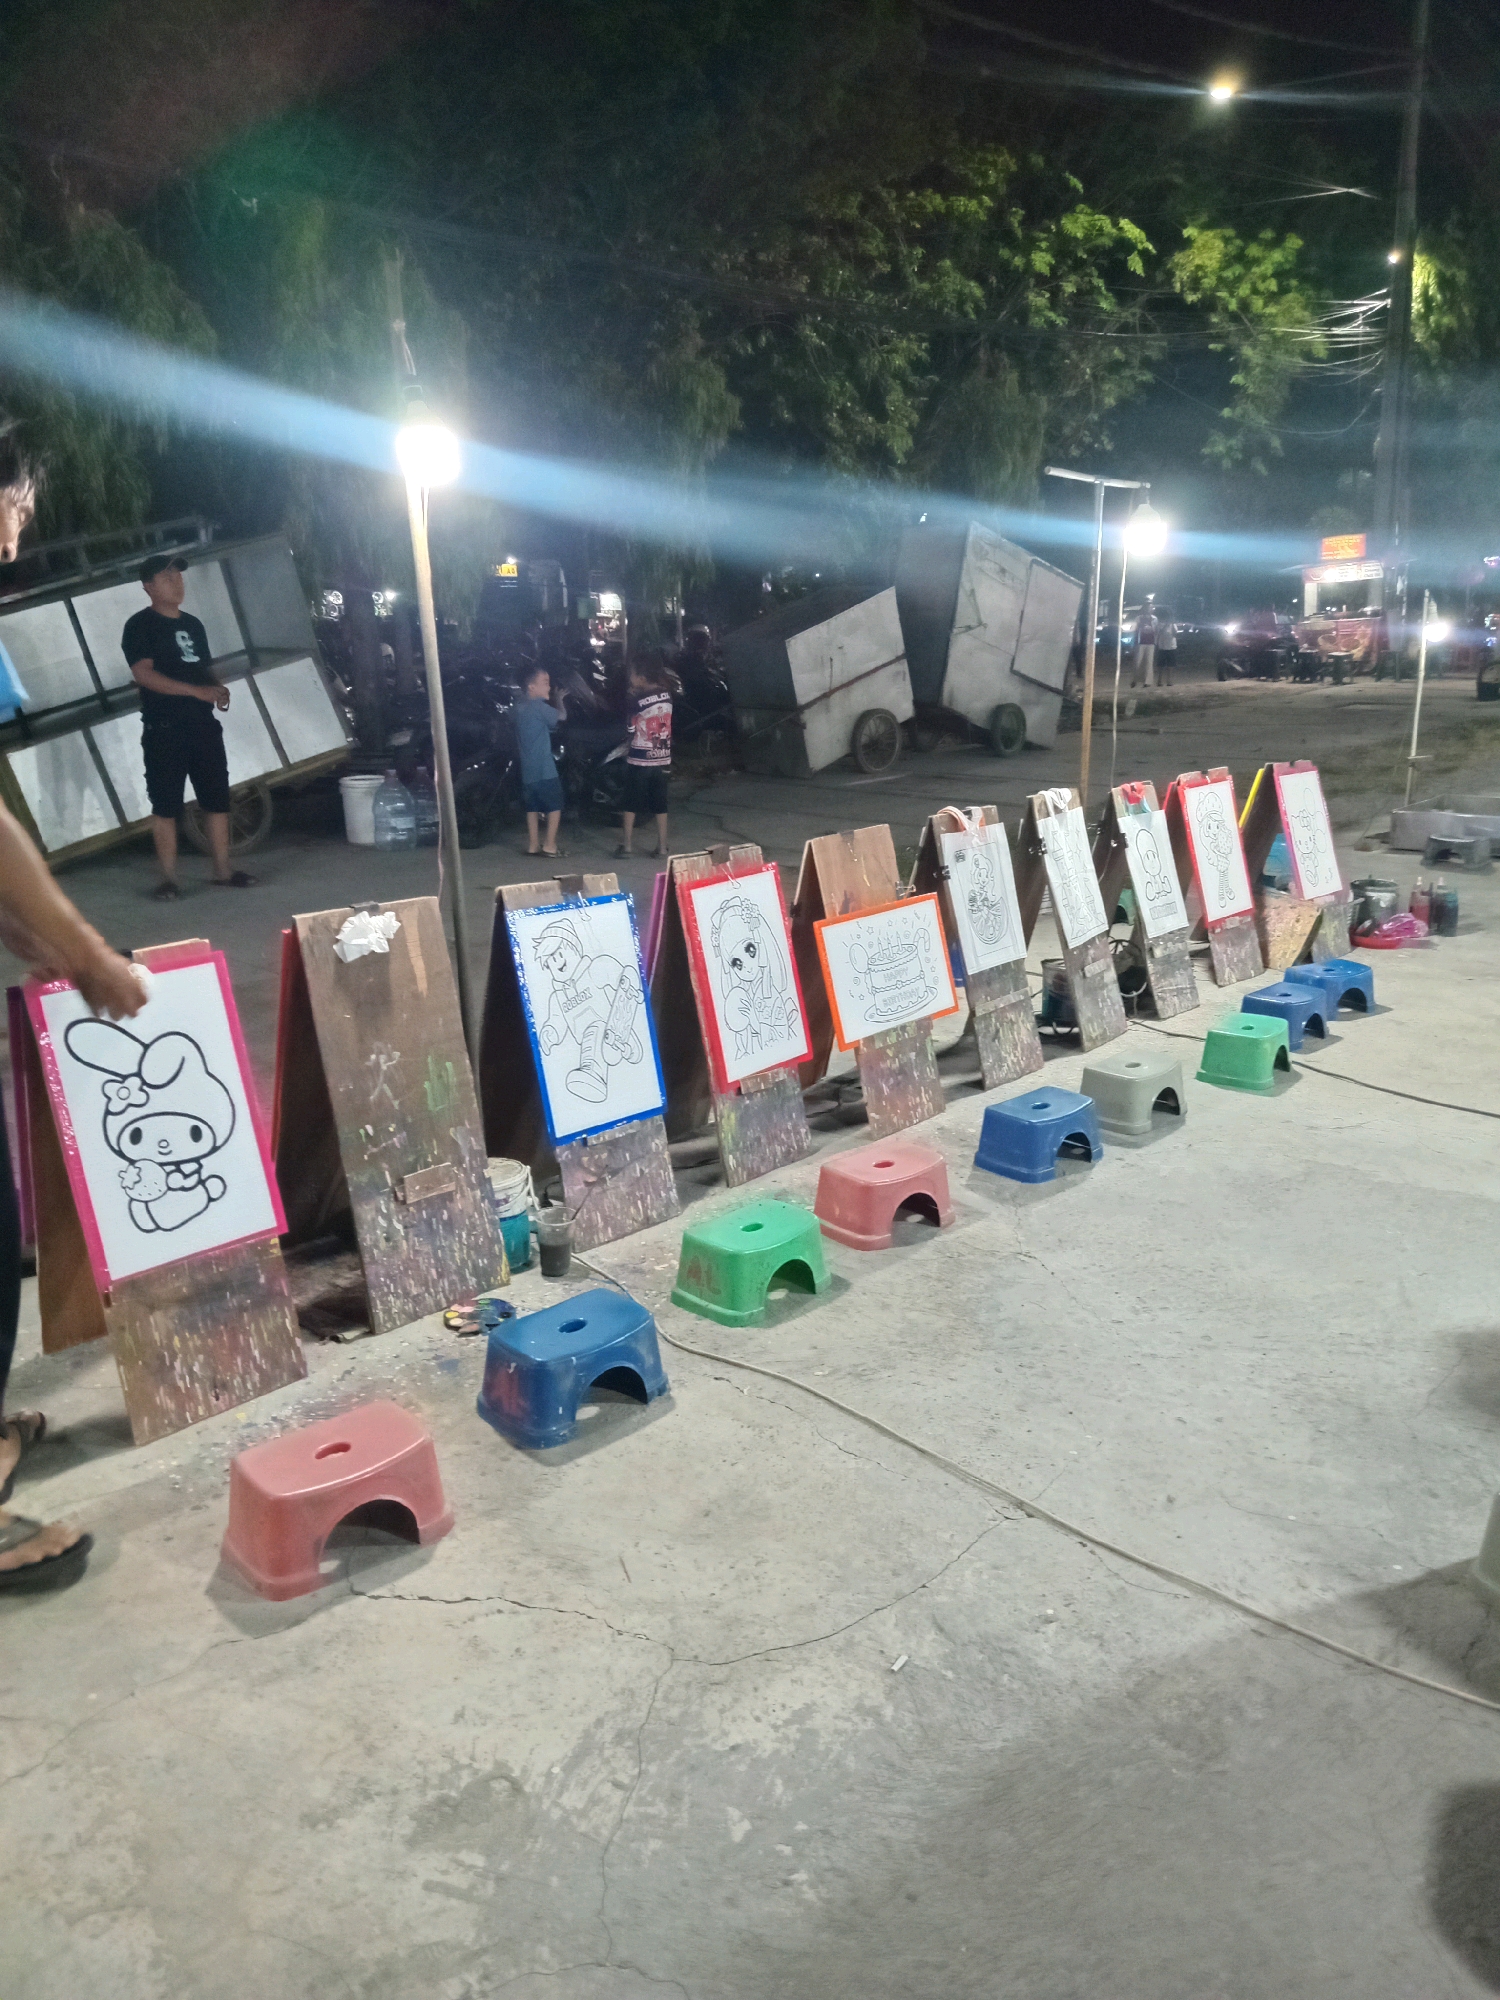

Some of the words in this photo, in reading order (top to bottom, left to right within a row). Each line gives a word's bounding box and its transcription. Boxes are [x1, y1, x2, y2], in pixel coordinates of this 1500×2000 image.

[638, 692, 671, 707] ROBLOX
[883, 966, 909, 983] HAPPY
[562, 986, 594, 1013] ROBLOX
[882, 986, 920, 1008] BIRTHDAY
